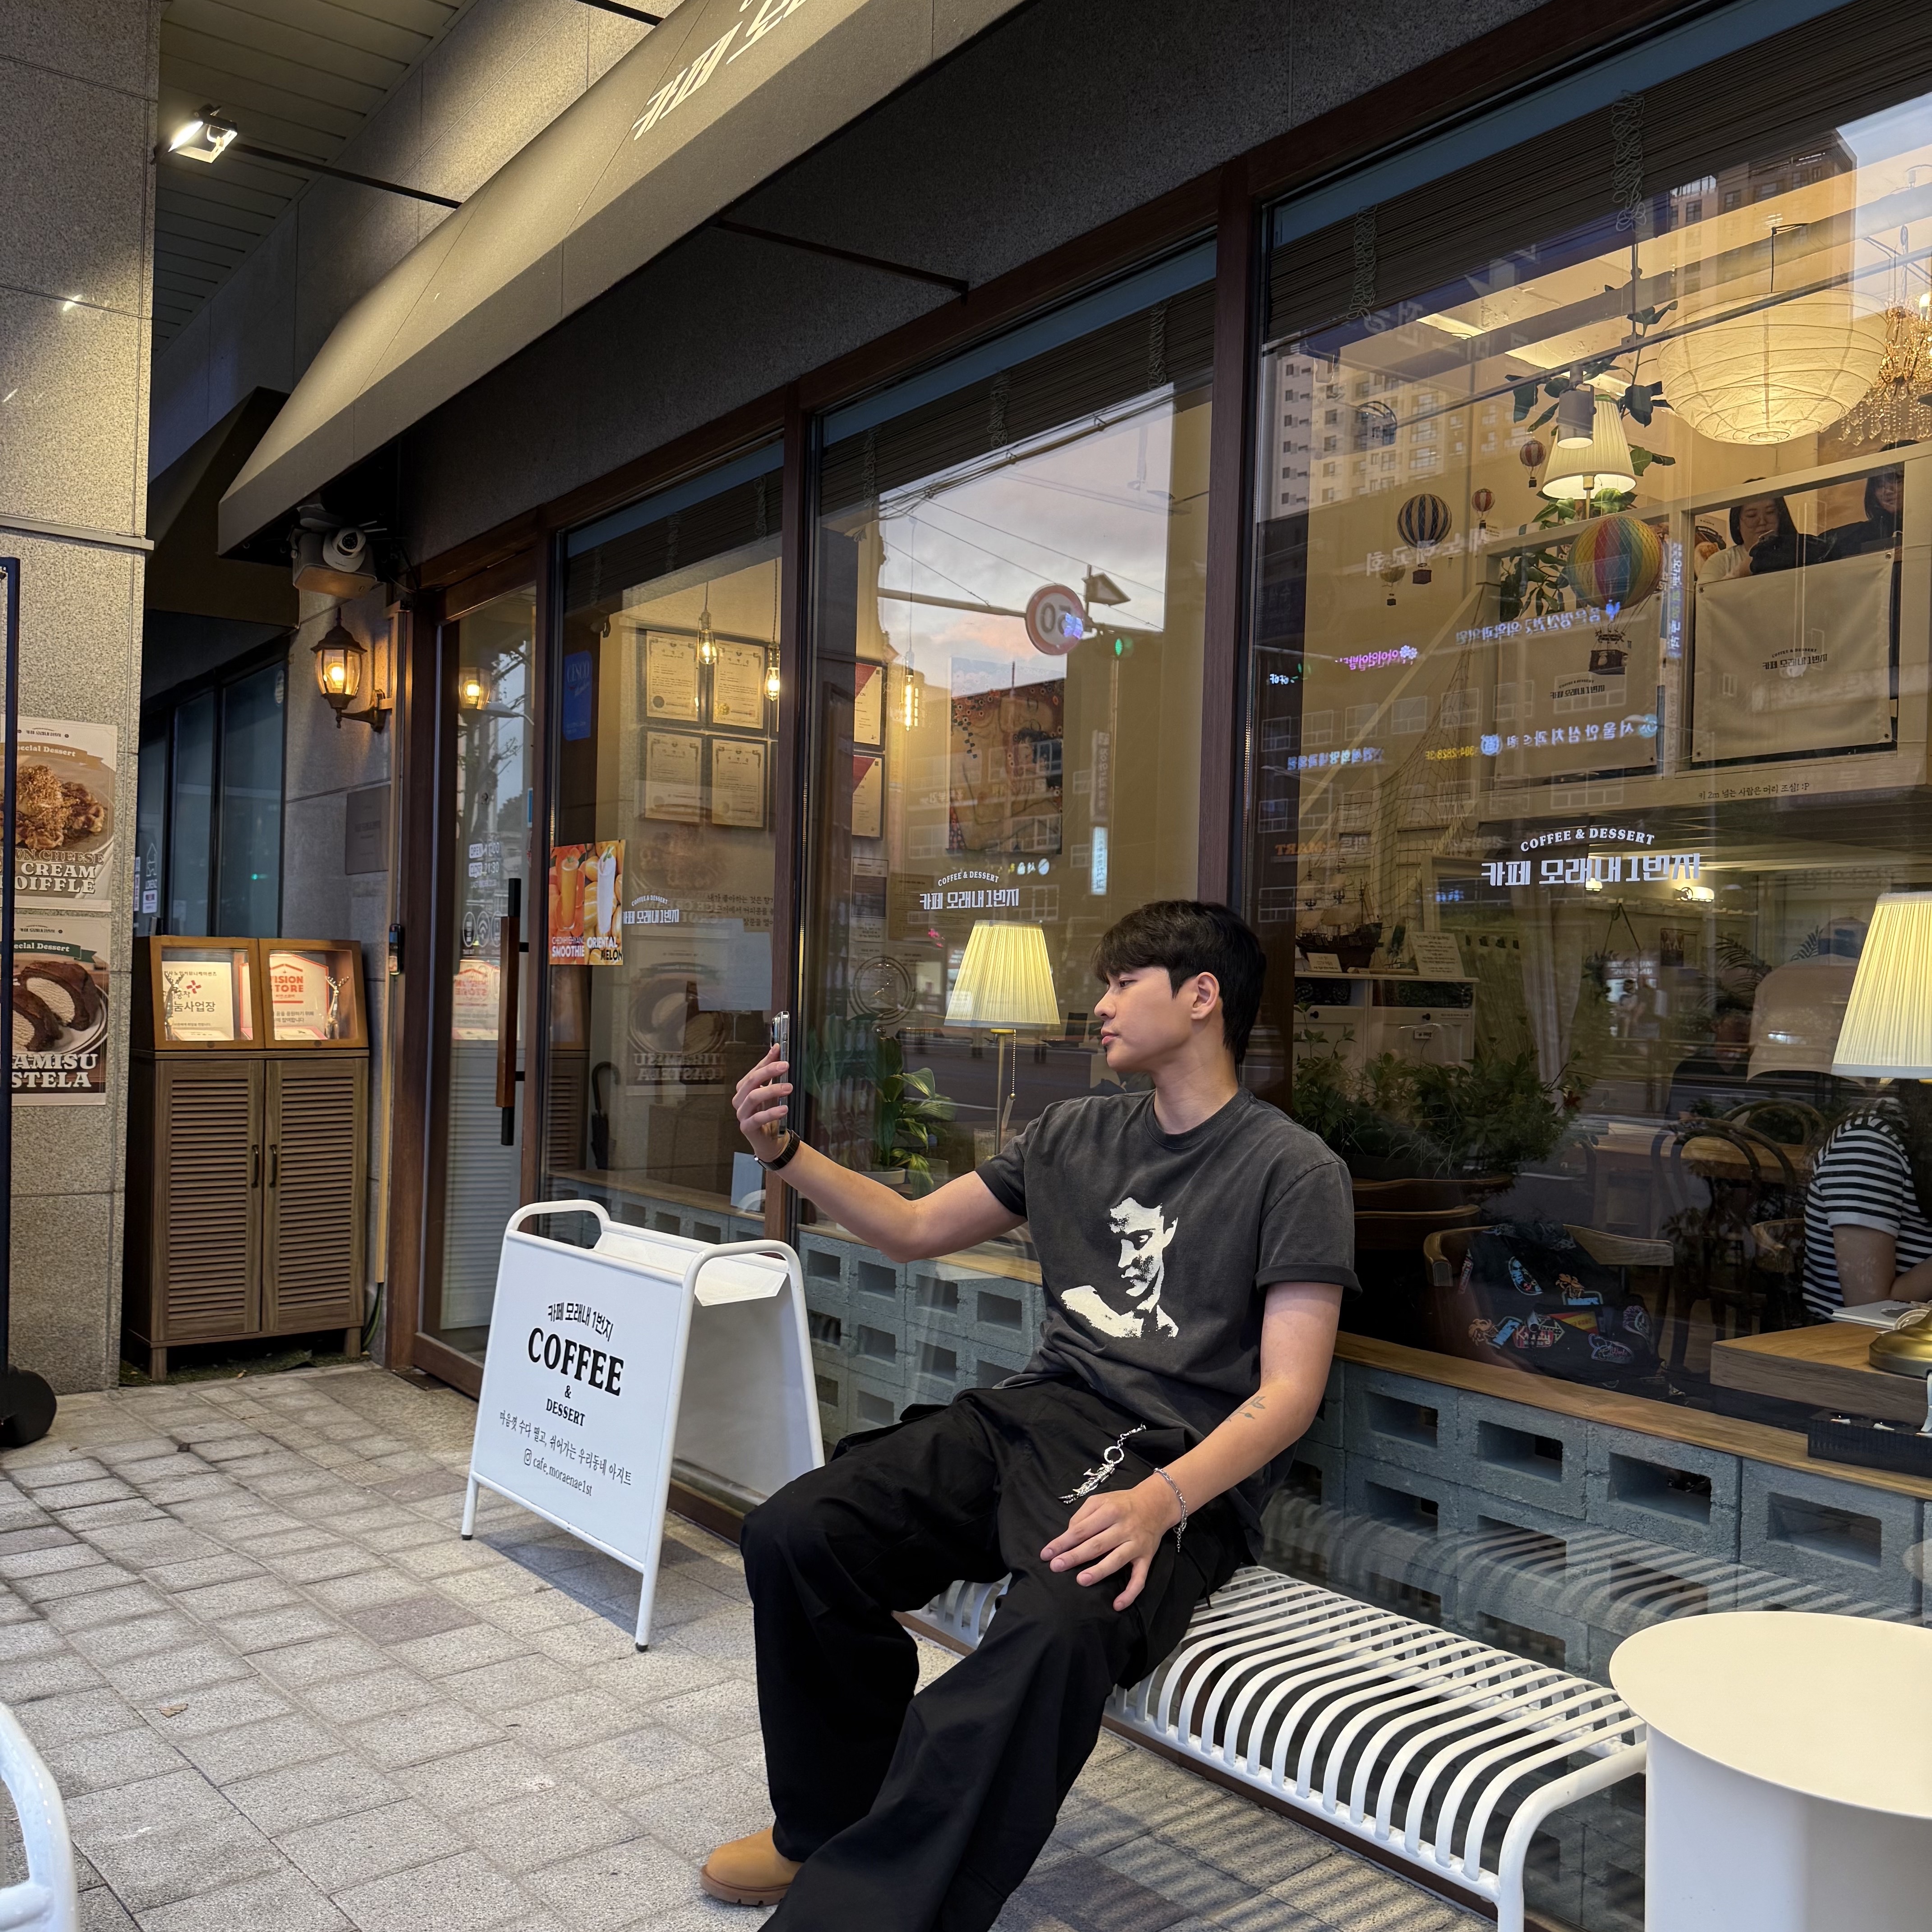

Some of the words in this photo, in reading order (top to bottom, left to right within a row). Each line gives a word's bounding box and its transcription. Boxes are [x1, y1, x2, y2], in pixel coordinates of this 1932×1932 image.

[631, 21, 743, 141] 카페
[1722, 789, 1737, 798] 넘는
[1739, 787, 1762, 797] 사람은
[1763, 784, 1778, 794] 머리
[1520, 830, 1571, 852] COFFEE
[1575, 828, 1584, 840] &
[1589, 828, 1655, 845] DESSERT
[39, 849, 104, 865] CHEESE
[21, 862, 96, 879] CREAM
[1481, 860, 1531, 886] 카페
[1539, 857, 1621, 885] 모래내
[1625, 853, 1700, 881] 1번지
[14, 875, 96, 894] OIFFLE
[938, 872, 962, 886] COFFEE
[963, 871, 968, 879] &
[969, 870, 999, 883] DESSERT
[750, 896, 762, 904] 것은
[920, 892, 943, 910] 카페
[946, 890, 984, 909] 모래내
[985, 888, 1019, 908] 1번지
[636, 910, 659, 924] 모래내
[660, 909, 680, 923] 1번지
[37, 943, 70, 952] Dessert
[587, 936, 618, 949] ORIENTAL
[552, 945, 585, 958] SMOOTHIE
[601, 950, 622, 961] MELON
[272, 975, 304, 984] ISION
[273, 984, 304, 992] TORE
[173, 1000, 216, 1013] 눔사업장
[12, 1053, 98, 1070] AMISU
[12, 1071, 92, 1088] STELA
[547, 1302, 565, 1322] 카페
[565, 1302, 592, 1326] 모래내
[592, 1310, 614, 1342] 1번지
[528, 1327, 624, 1396] COFFEE
[564, 1385, 571, 1399] &
[546, 1398, 586, 1427] DESSERT
[500, 1409, 518, 1432] 마음껏
[519, 1419, 531, 1438] 수다
[534, 1427, 547, 1448] 떨고,
[550, 1435, 577, 1460] 쉬어가는
[578, 1448, 607, 1476] 우리동네
[609, 1463, 632, 1486] 아지트
[533, 1457, 593, 1497] cafe.moraenae1st
